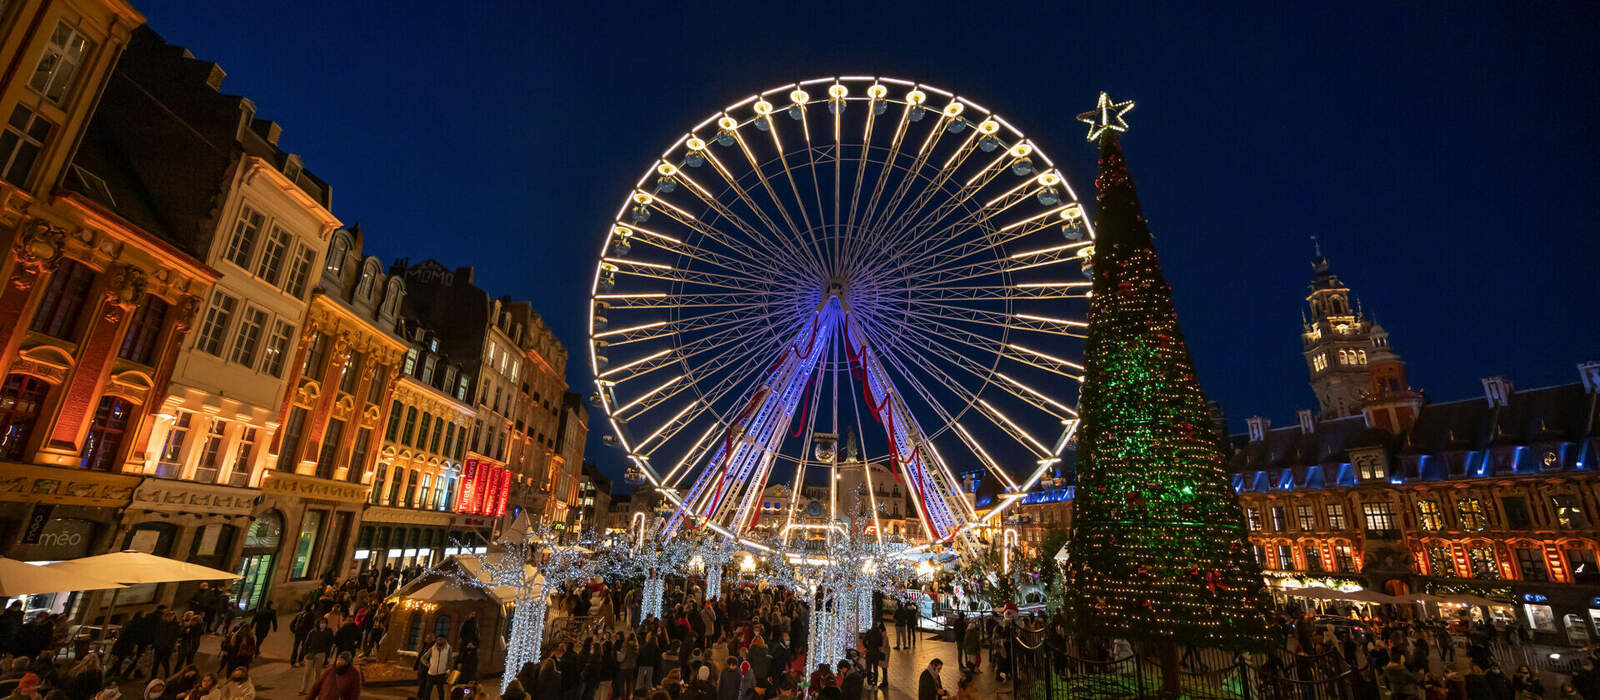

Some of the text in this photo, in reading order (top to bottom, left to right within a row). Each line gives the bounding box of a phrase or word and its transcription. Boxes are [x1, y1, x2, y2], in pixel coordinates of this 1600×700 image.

[404, 271, 455, 287] MOMO
[459, 461, 476, 510] Furet du nord
